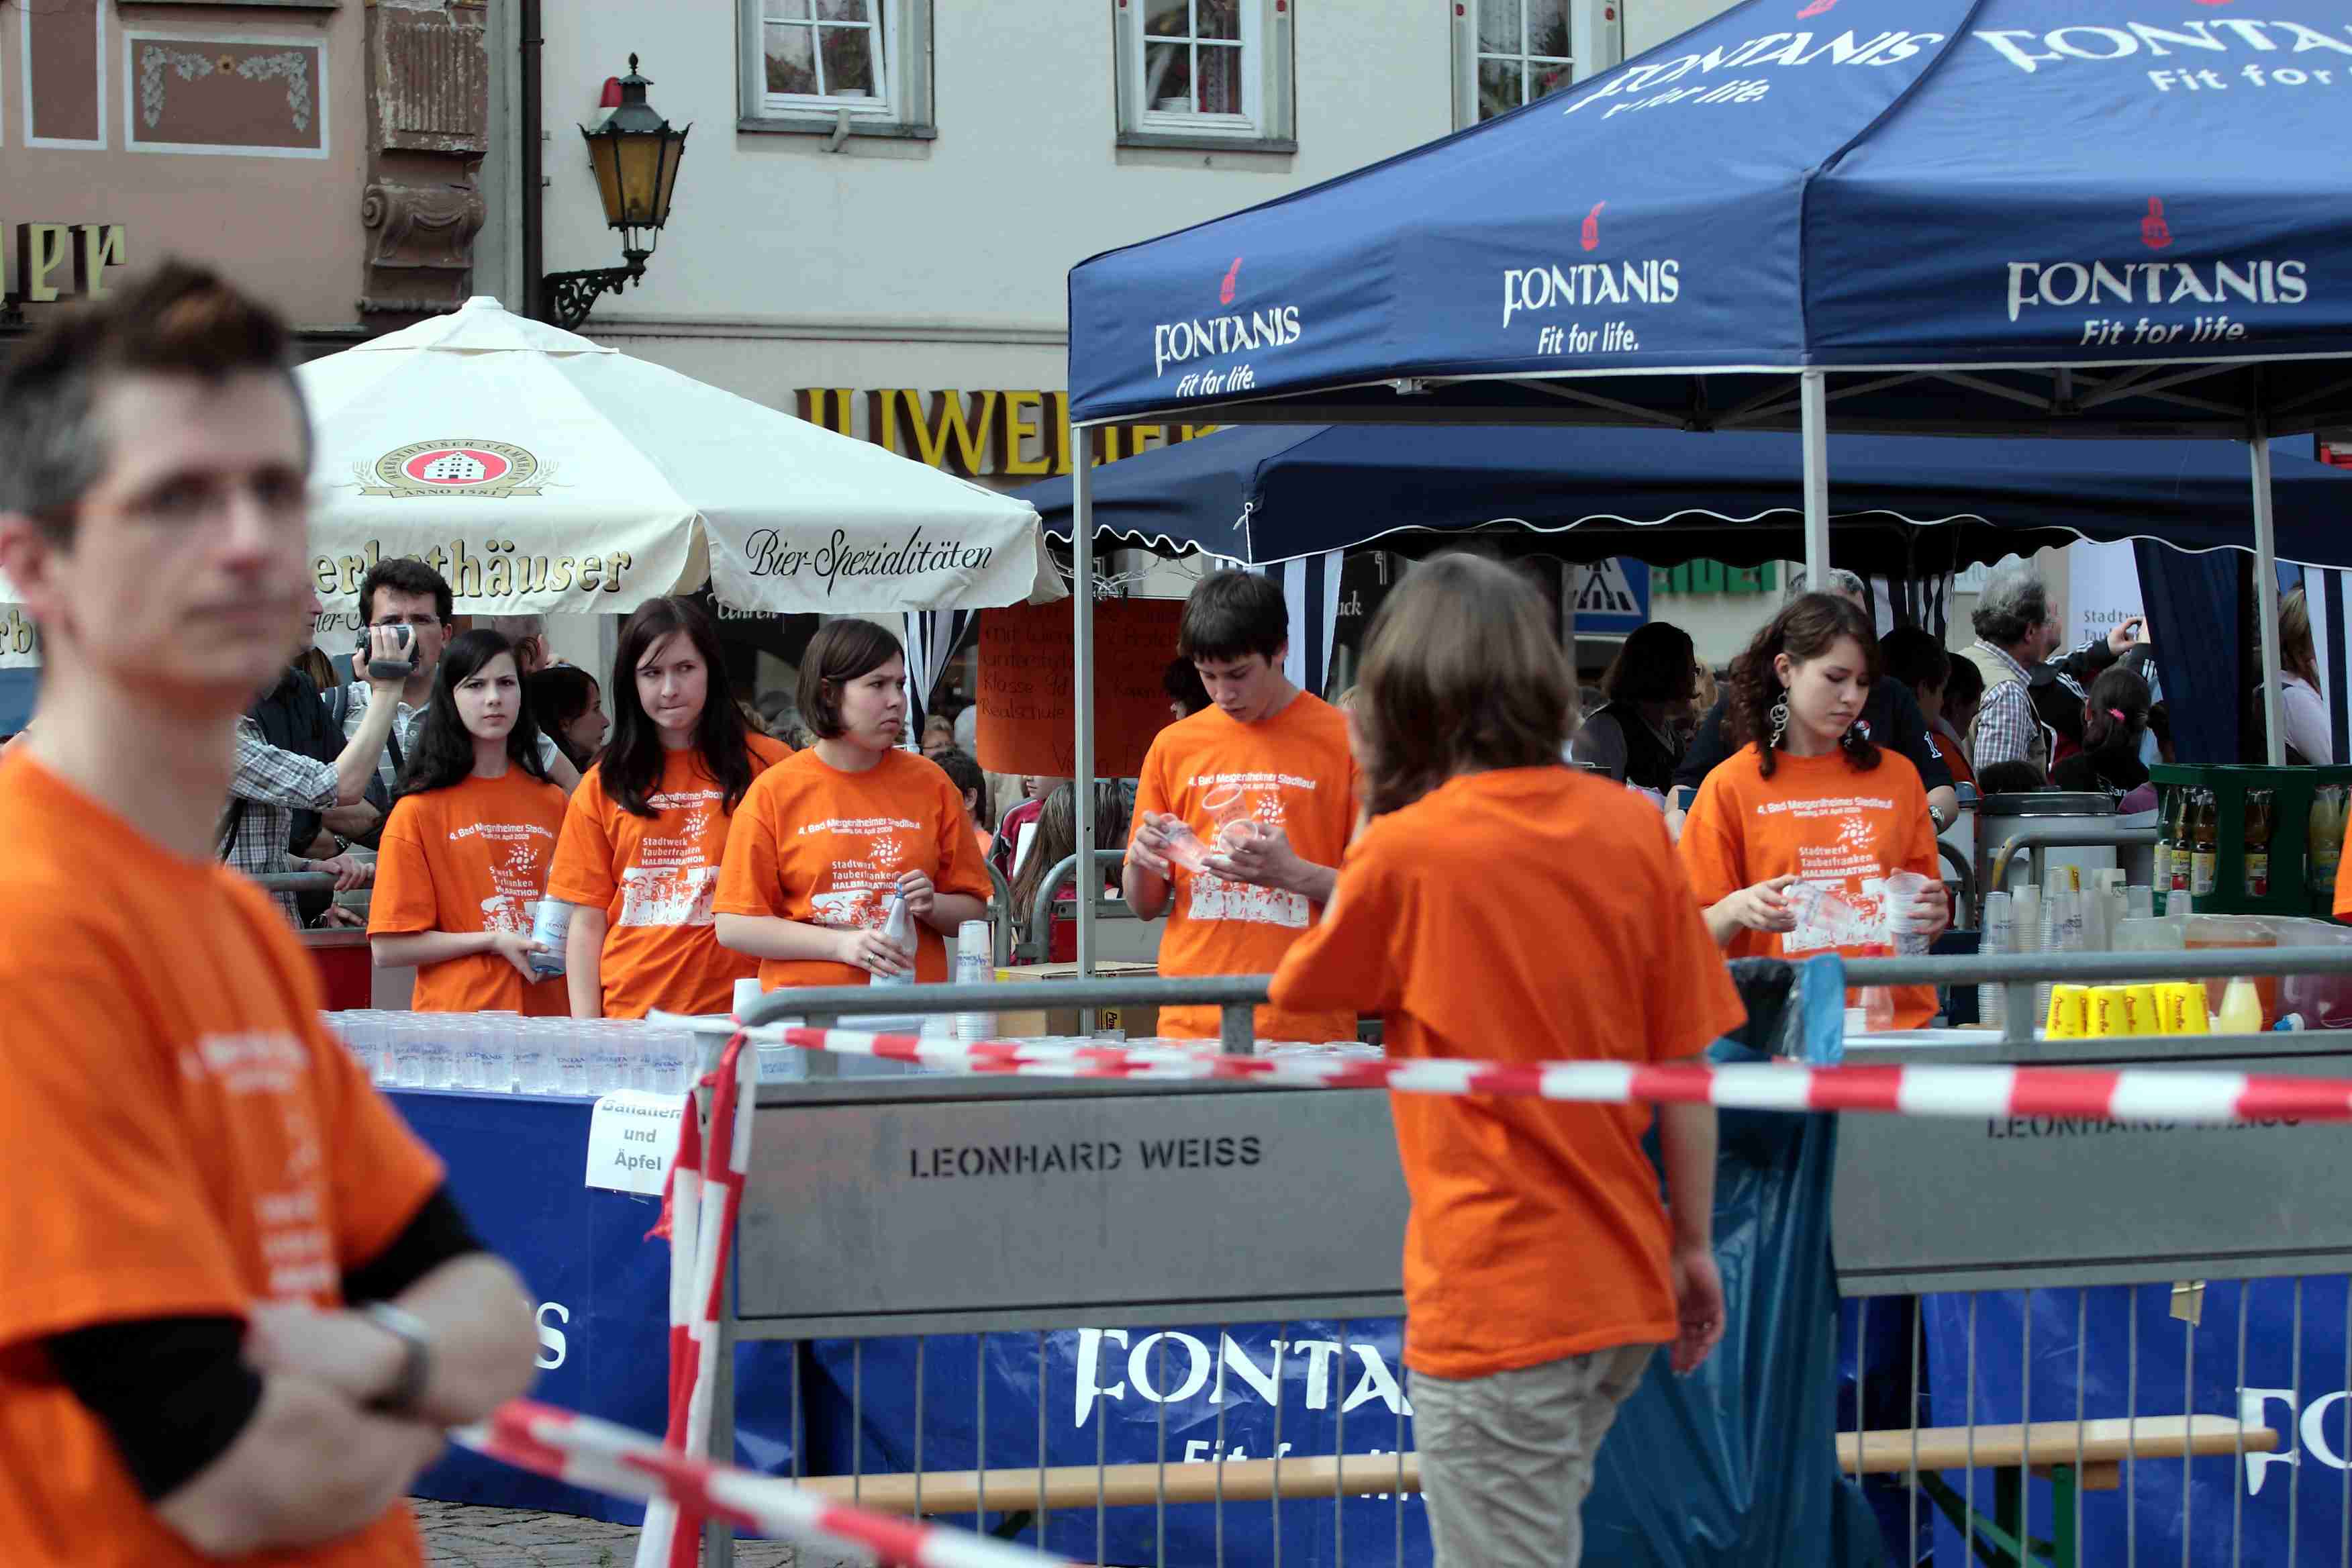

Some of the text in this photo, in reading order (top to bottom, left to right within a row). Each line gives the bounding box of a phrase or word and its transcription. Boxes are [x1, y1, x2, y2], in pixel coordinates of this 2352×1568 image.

[1972, 19, 2352, 73] FONTA
[1562, 30, 1945, 115] FONTANIS
[2148, 64, 2333, 91] Fit for
[1503, 259, 1679, 328] FONTANIS
[2007, 260, 2308, 322] FONTANIS
[1155, 306, 1301, 378] FONTANIS
[1538, 321, 1639, 354] Fit for life.
[2080, 318, 2124, 345] Fit
[2133, 317, 2184, 344] for
[1176, 364, 1255, 397] Fit for life.
[404, 488, 452, 496] ANNO
[745, 526, 993, 597] Bier-Spezialitäten
[642, 838, 687, 846] Stadtwerk
[624, 1128, 656, 1143] und
[614, 1148, 661, 1171] Äpfel
[910, 1136, 1261, 1177] LEONHARD WEISS
[1075, 1328, 1414, 1428] FONTA
